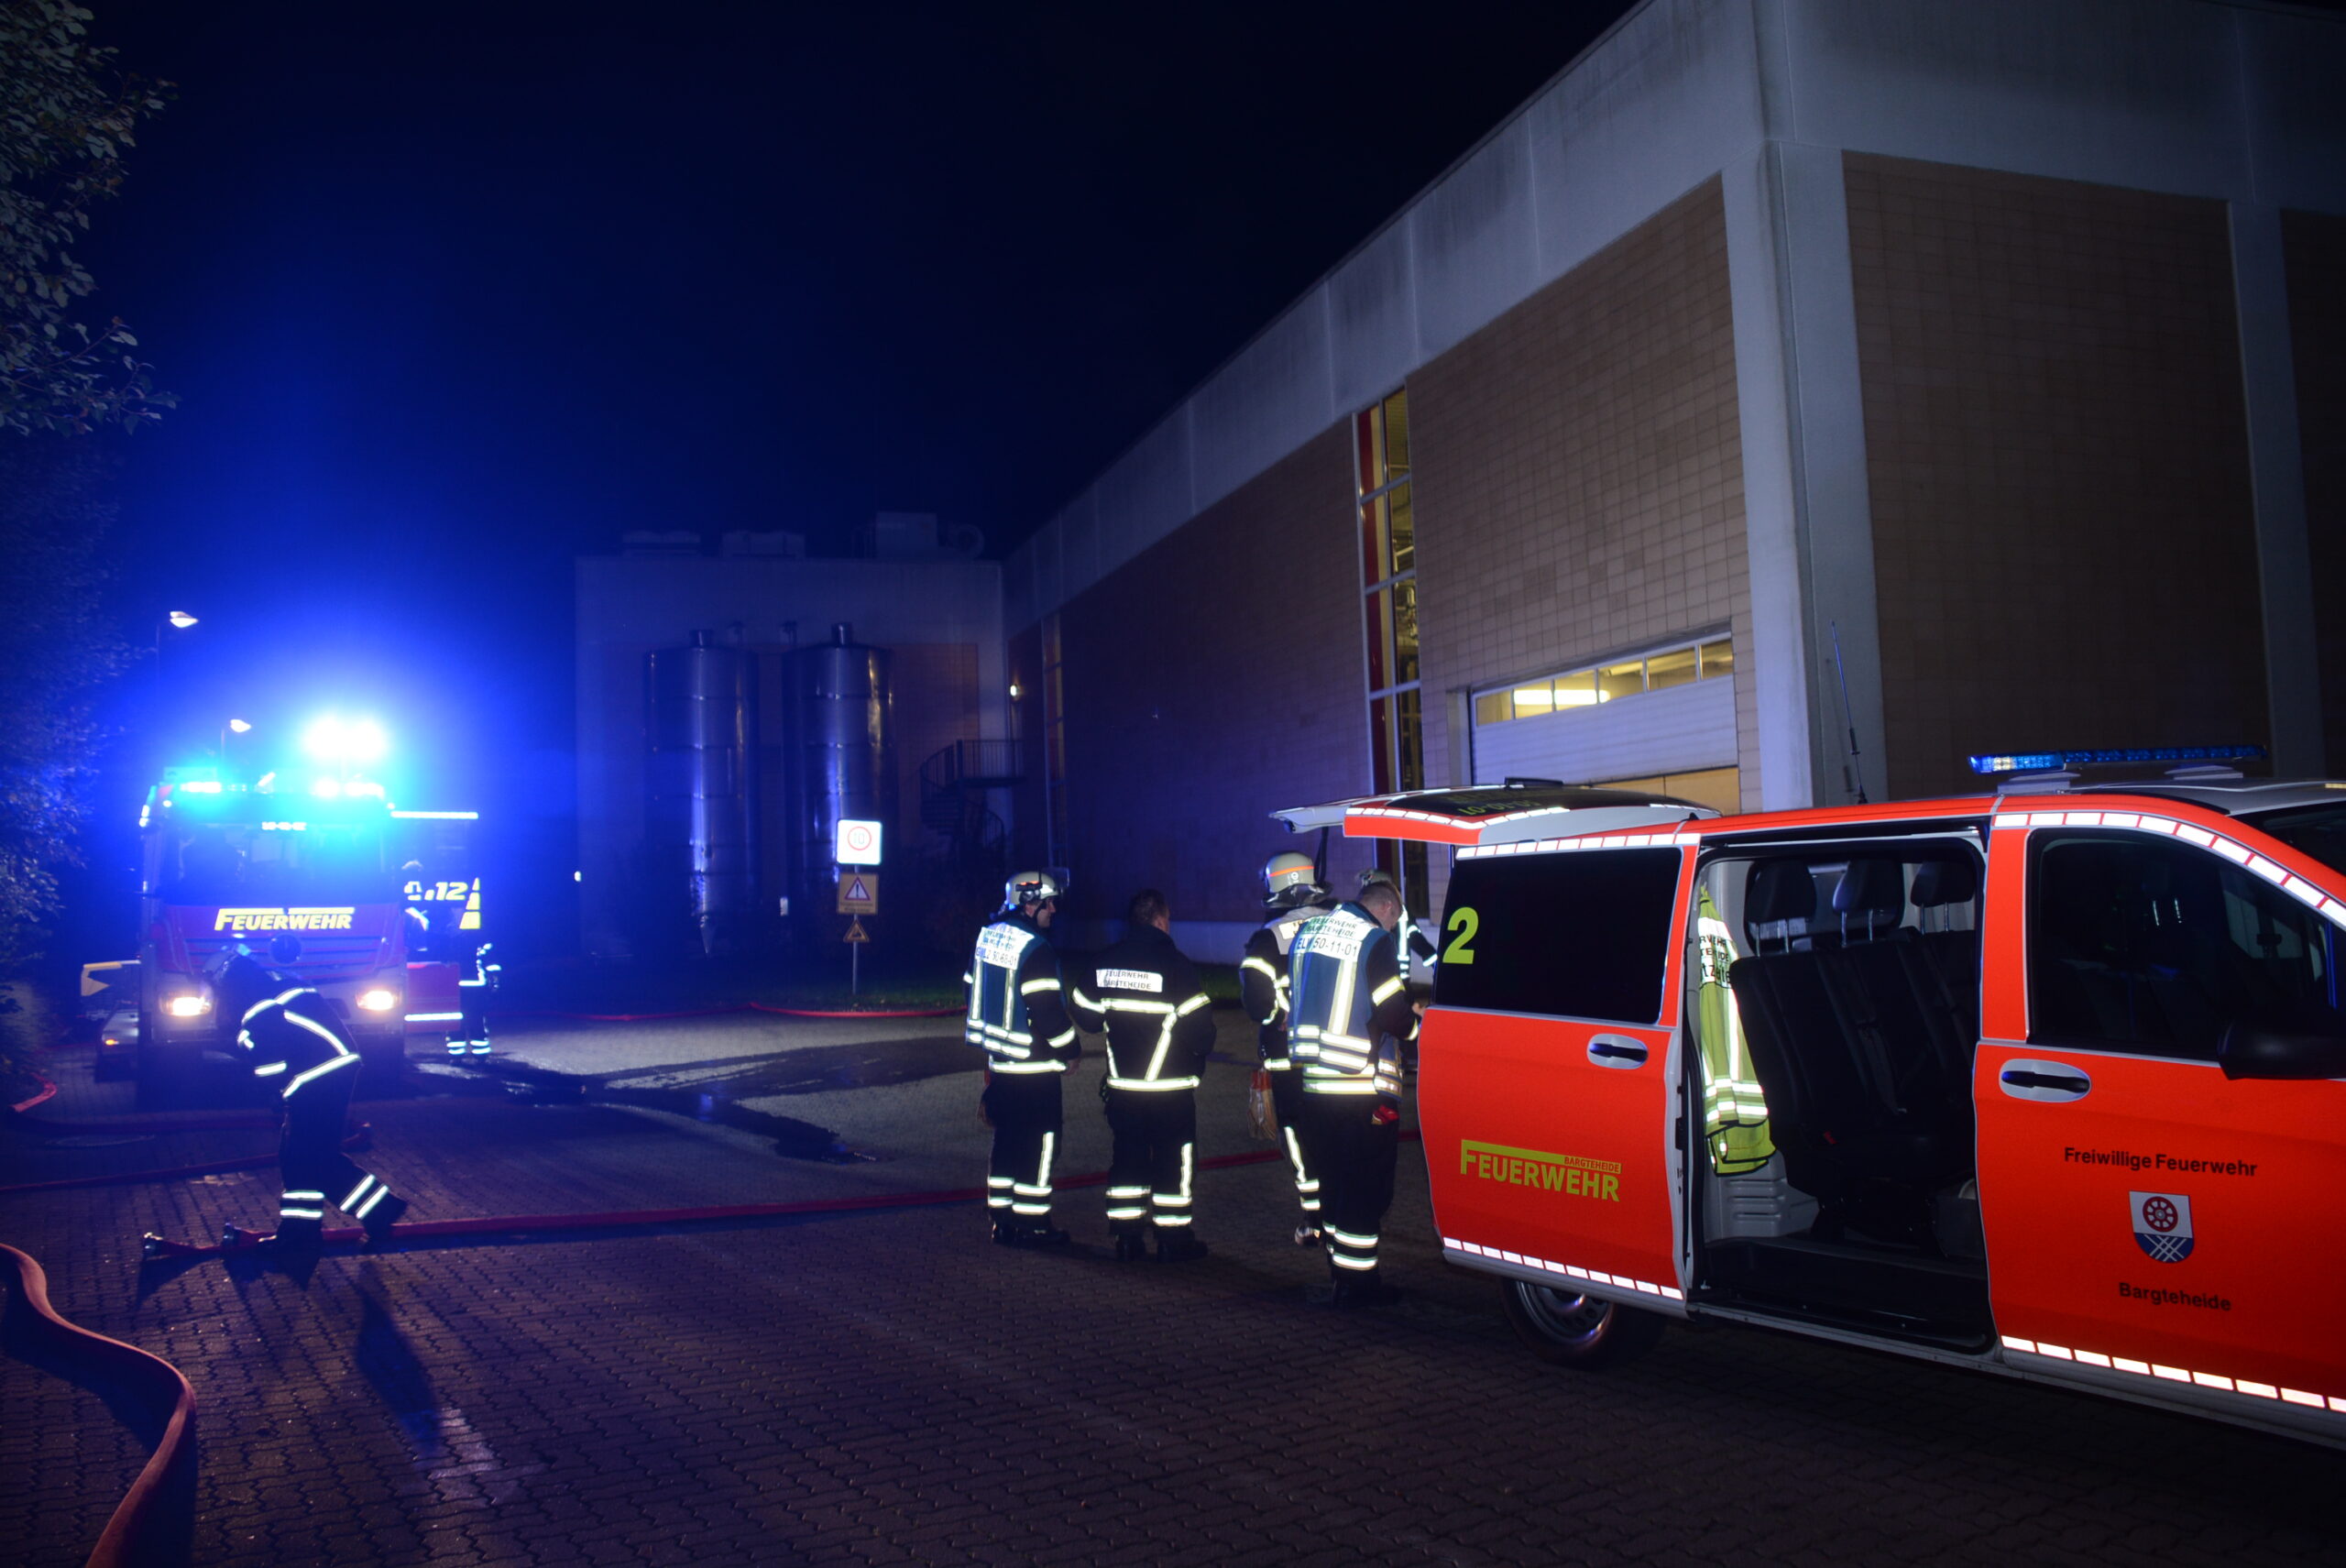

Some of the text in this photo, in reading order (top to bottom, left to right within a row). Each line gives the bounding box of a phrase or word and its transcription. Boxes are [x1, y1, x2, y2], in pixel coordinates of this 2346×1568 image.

[214, 908, 353, 931] FEUERWEHR
[1313, 938, 1357, 956] 50-11-01
[1442, 906, 1479, 965] 2
[1461, 1139, 1620, 1202] FEUERWEHR
[1563, 1157, 1620, 1173] BARGTEHEIDE
[2064, 1146, 2258, 1177] Freiwillige Feuerwehr
[2119, 1282, 2232, 1311] Bargteheide
